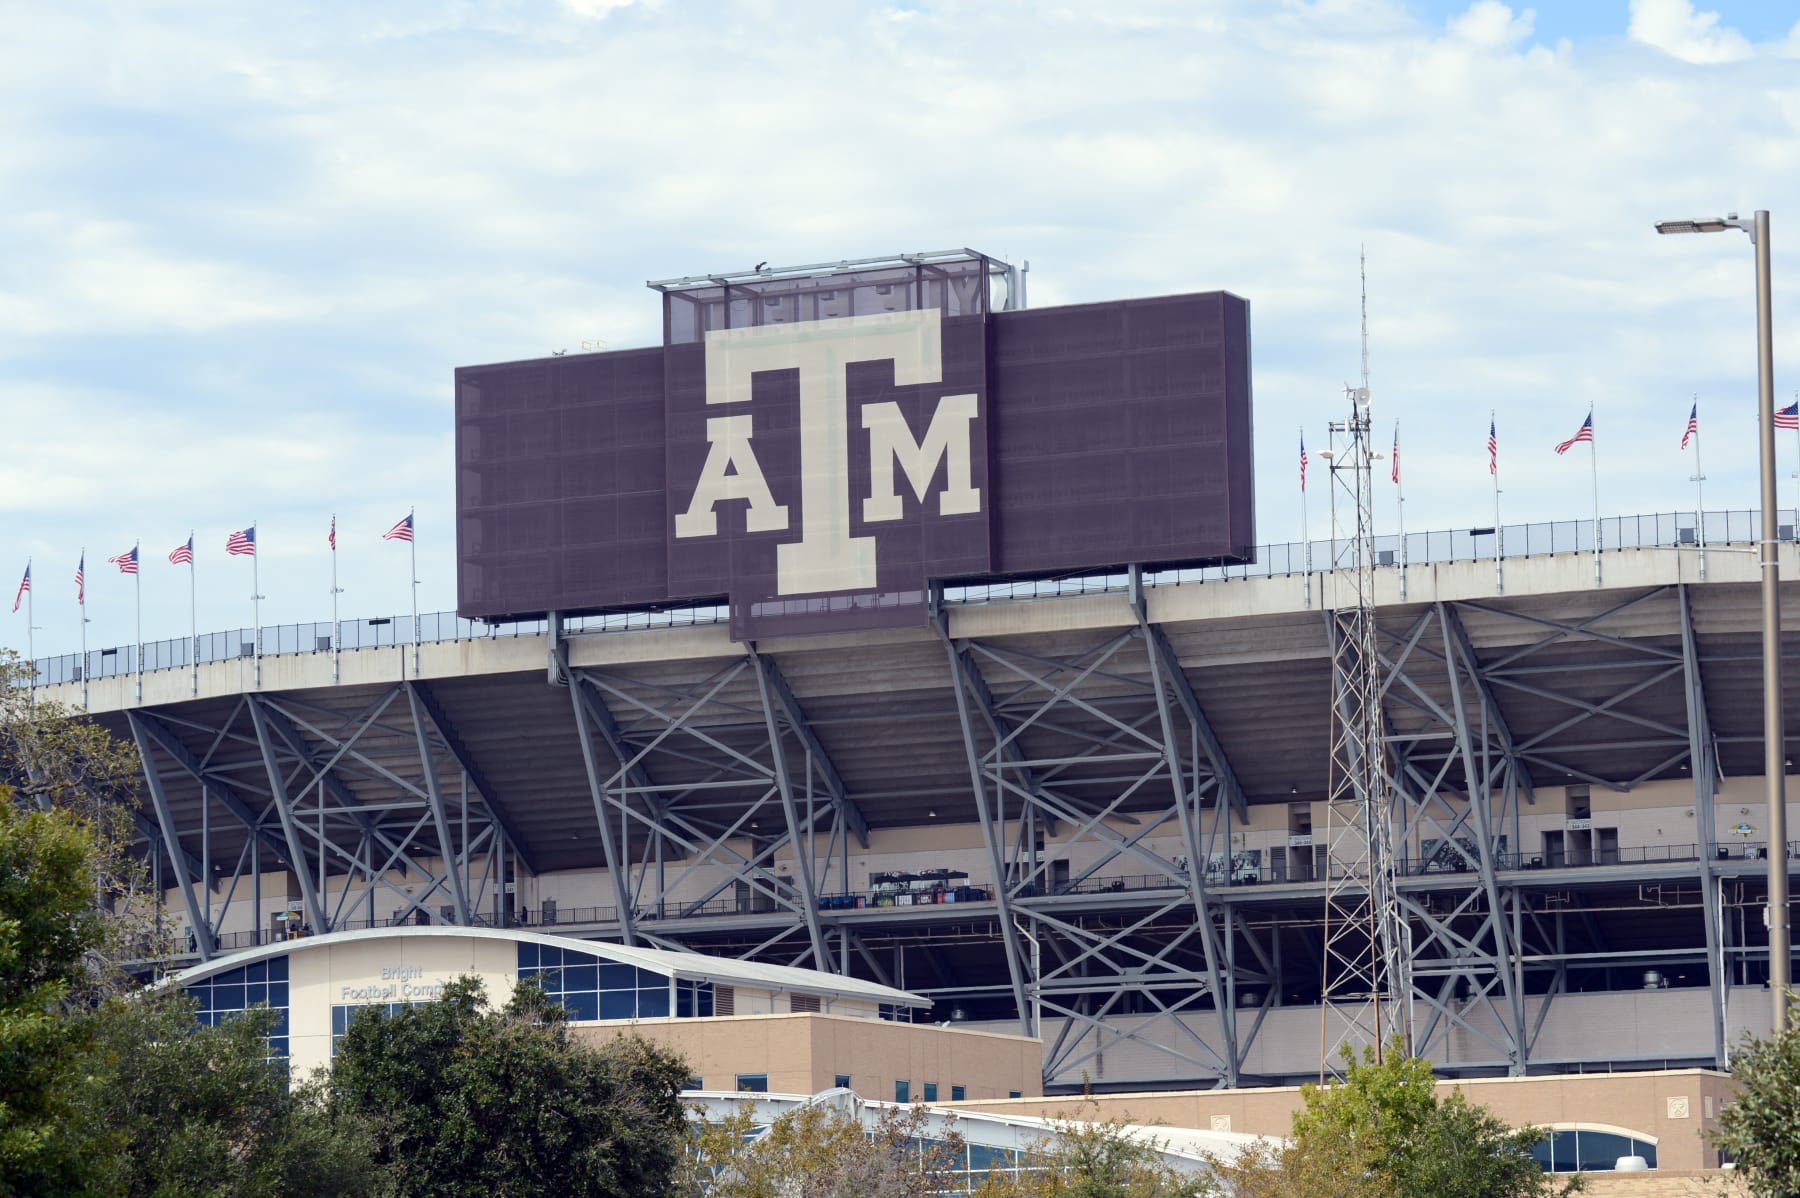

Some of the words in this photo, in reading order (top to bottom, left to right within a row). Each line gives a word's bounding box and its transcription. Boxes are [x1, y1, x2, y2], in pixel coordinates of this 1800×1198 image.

[381, 965, 422, 982] Bright
[341, 984, 397, 1000] Football
[402, 983, 443, 998] Comp
